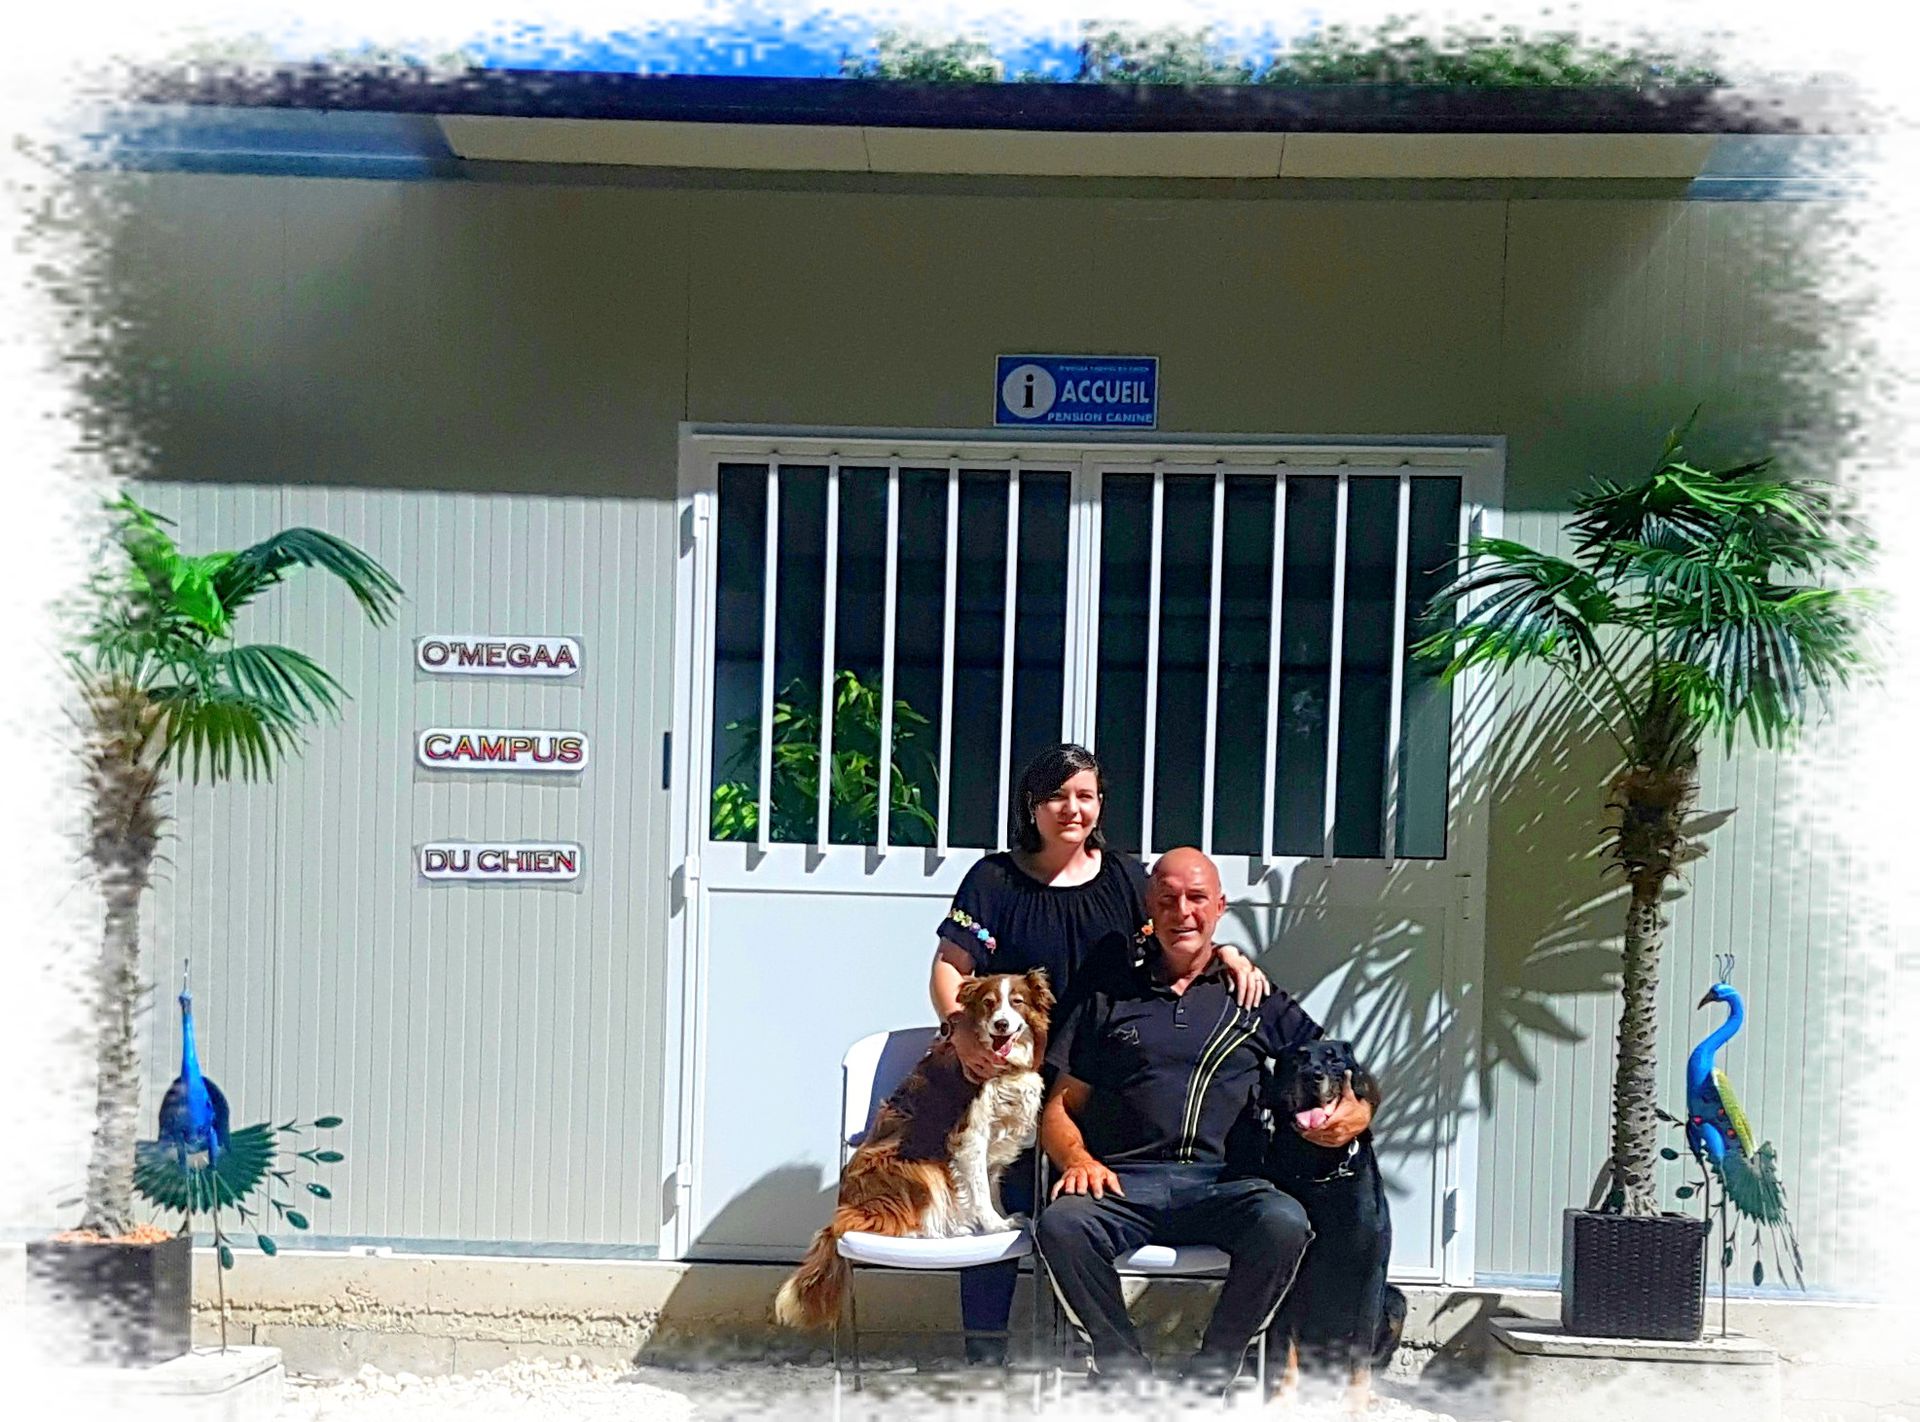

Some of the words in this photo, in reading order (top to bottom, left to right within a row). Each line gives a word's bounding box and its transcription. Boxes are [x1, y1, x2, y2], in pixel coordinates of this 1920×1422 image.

[1061, 380, 1149, 403] ACCUEIL
[1048, 412, 1102, 422] PENSION
[1106, 413, 1153, 423] CANINE
[422, 641, 577, 668] O'MEGAA
[425, 734, 583, 763] CAMPUS
[425, 849, 470, 872] DU
[477, 850, 576, 873] CHIEN
